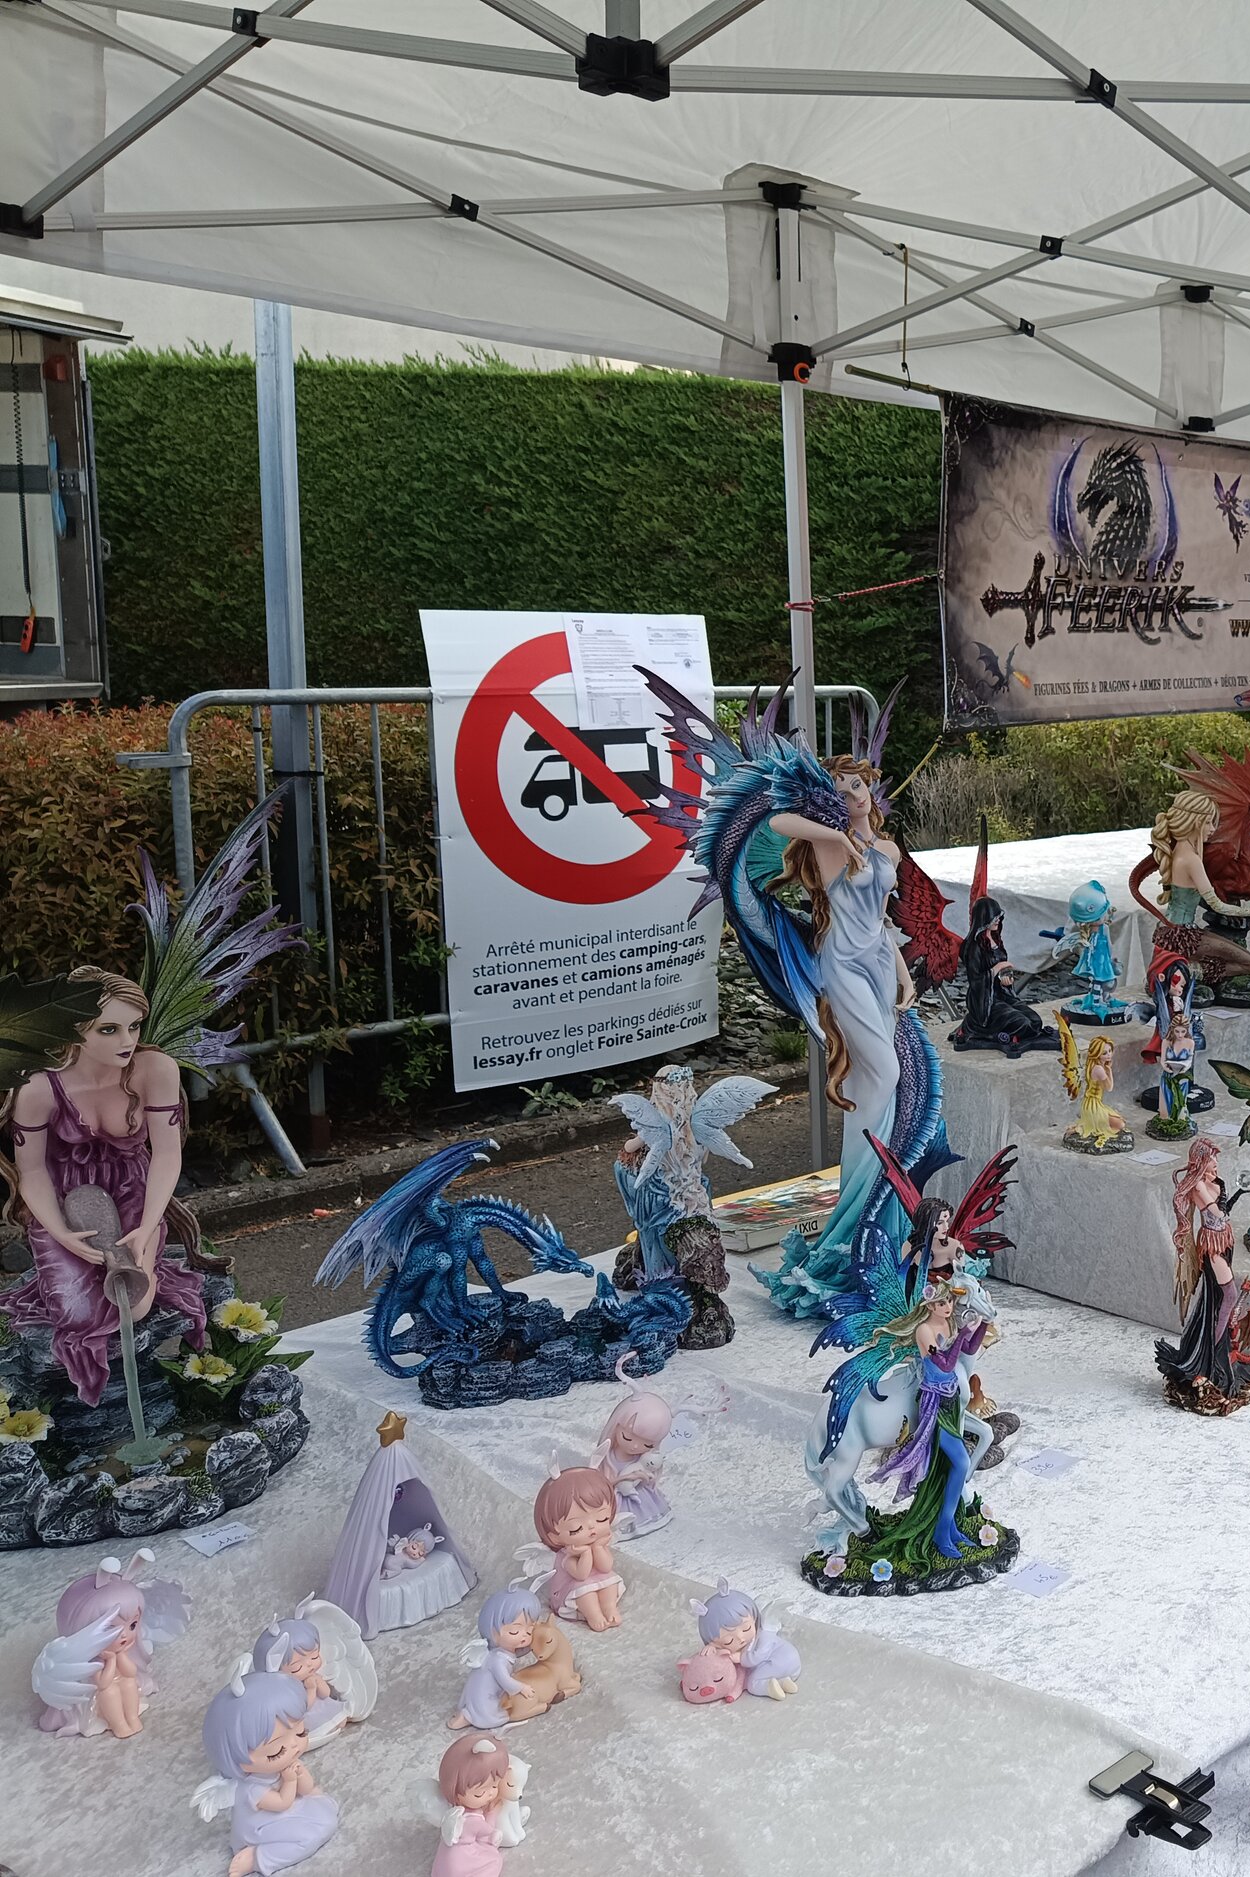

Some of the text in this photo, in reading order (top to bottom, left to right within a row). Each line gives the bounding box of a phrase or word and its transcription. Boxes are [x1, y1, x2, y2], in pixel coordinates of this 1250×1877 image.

[1054, 553, 1184, 583] UNIVERS
[1037, 576, 1203, 645] FEERIK
[1034, 682, 1070, 696] FIGURINES
[1073, 679, 1089, 694] FÉES
[1099, 679, 1130, 693] DRAGONS
[1139, 678, 1160, 691] ARMES
[1163, 678, 1171, 690] DE
[1173, 677, 1211, 689] COLLECTION
[473, 935, 707, 978] stationnement des camping-cars,
[486, 920, 697, 958] Arrêté municipal interdisant le
[474, 948, 706, 996] caravanes et camions aménagés
[513, 973, 682, 1010] avant et pendant la foire.
[473, 1012, 707, 1070] lessay.fr onglet Foire Sainte-Croix
[482, 999, 703, 1050] Retrouvez les parkings dédiés sur
[795, 1220, 818, 1233] DIXI
